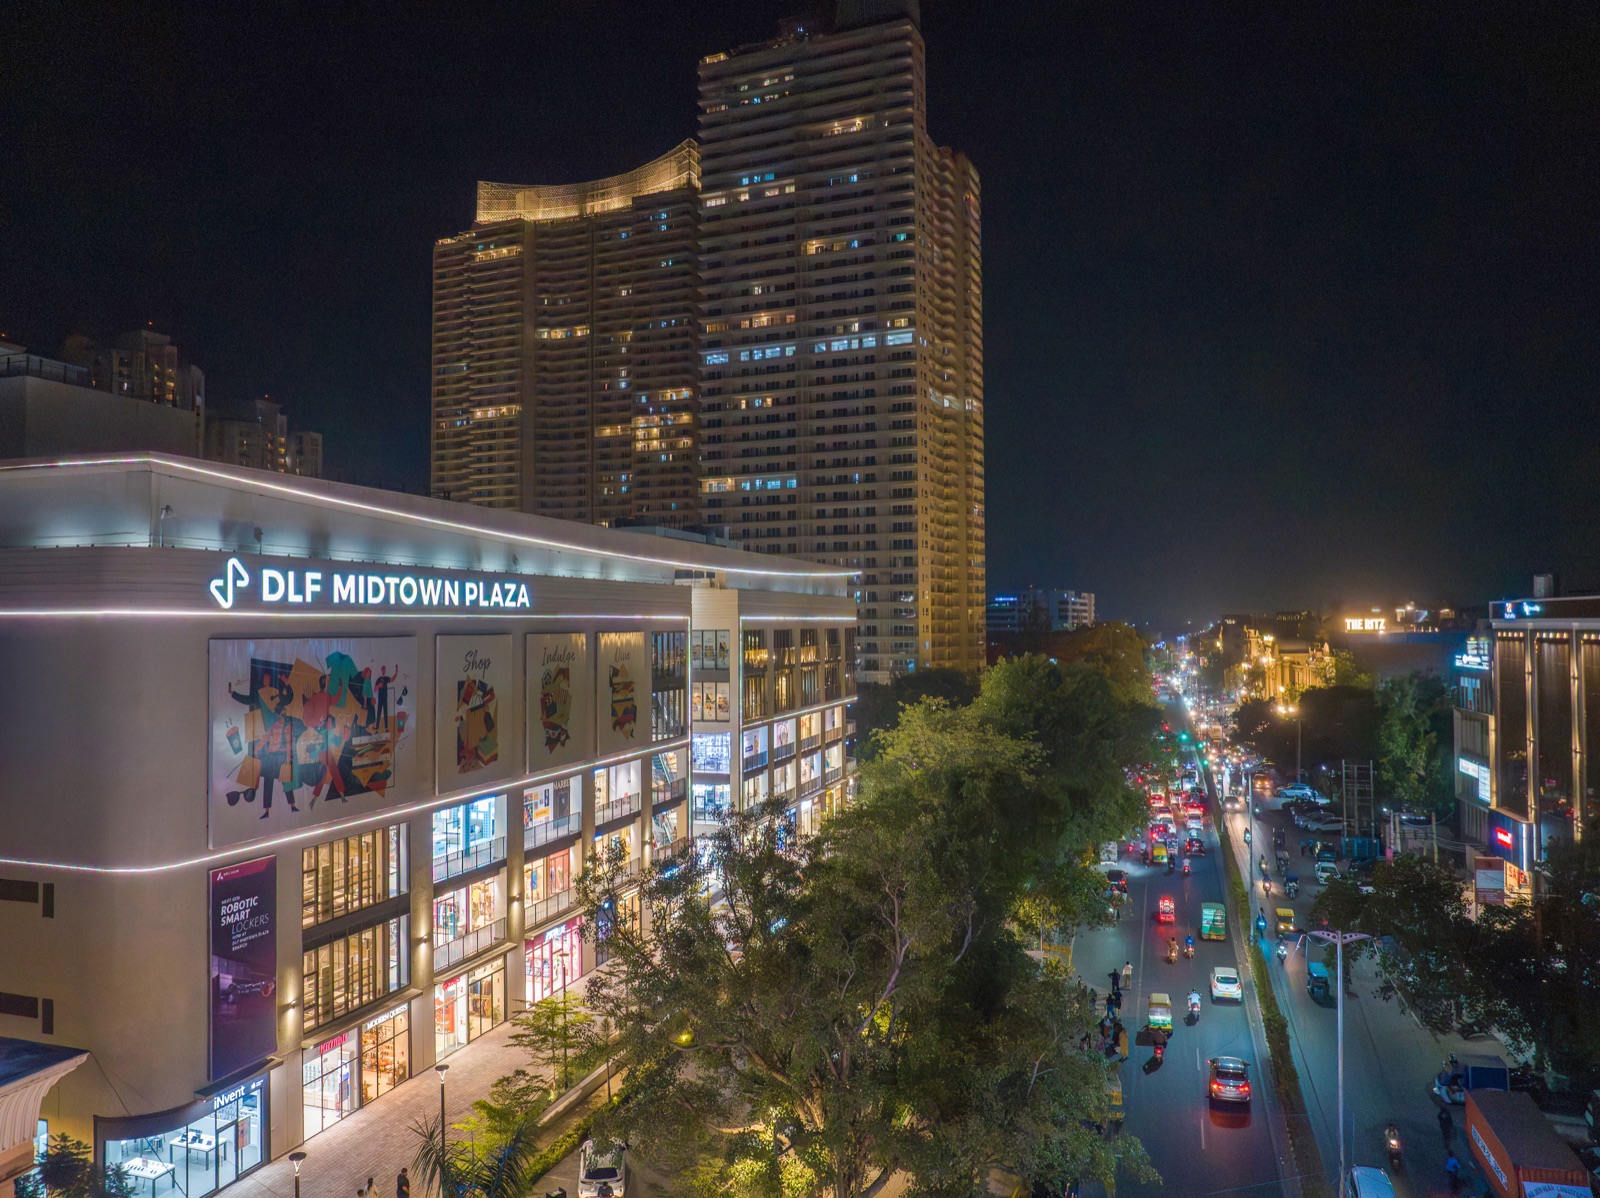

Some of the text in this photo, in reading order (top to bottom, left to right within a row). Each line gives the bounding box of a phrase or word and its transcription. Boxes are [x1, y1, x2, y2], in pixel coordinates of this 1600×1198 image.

[262, 570, 531, 609] DLF MIDTOWN PLAZA
[1345, 618, 1386, 630] THE RITZ
[463, 650, 491, 679] Shop
[542, 645, 575, 666] Indulge
[221, 896, 258, 916] ROBOTIC
[221, 909, 250, 926] SMART
[232, 913, 269, 934] LOCKERS
[213, 1085, 246, 1110] iNvent
